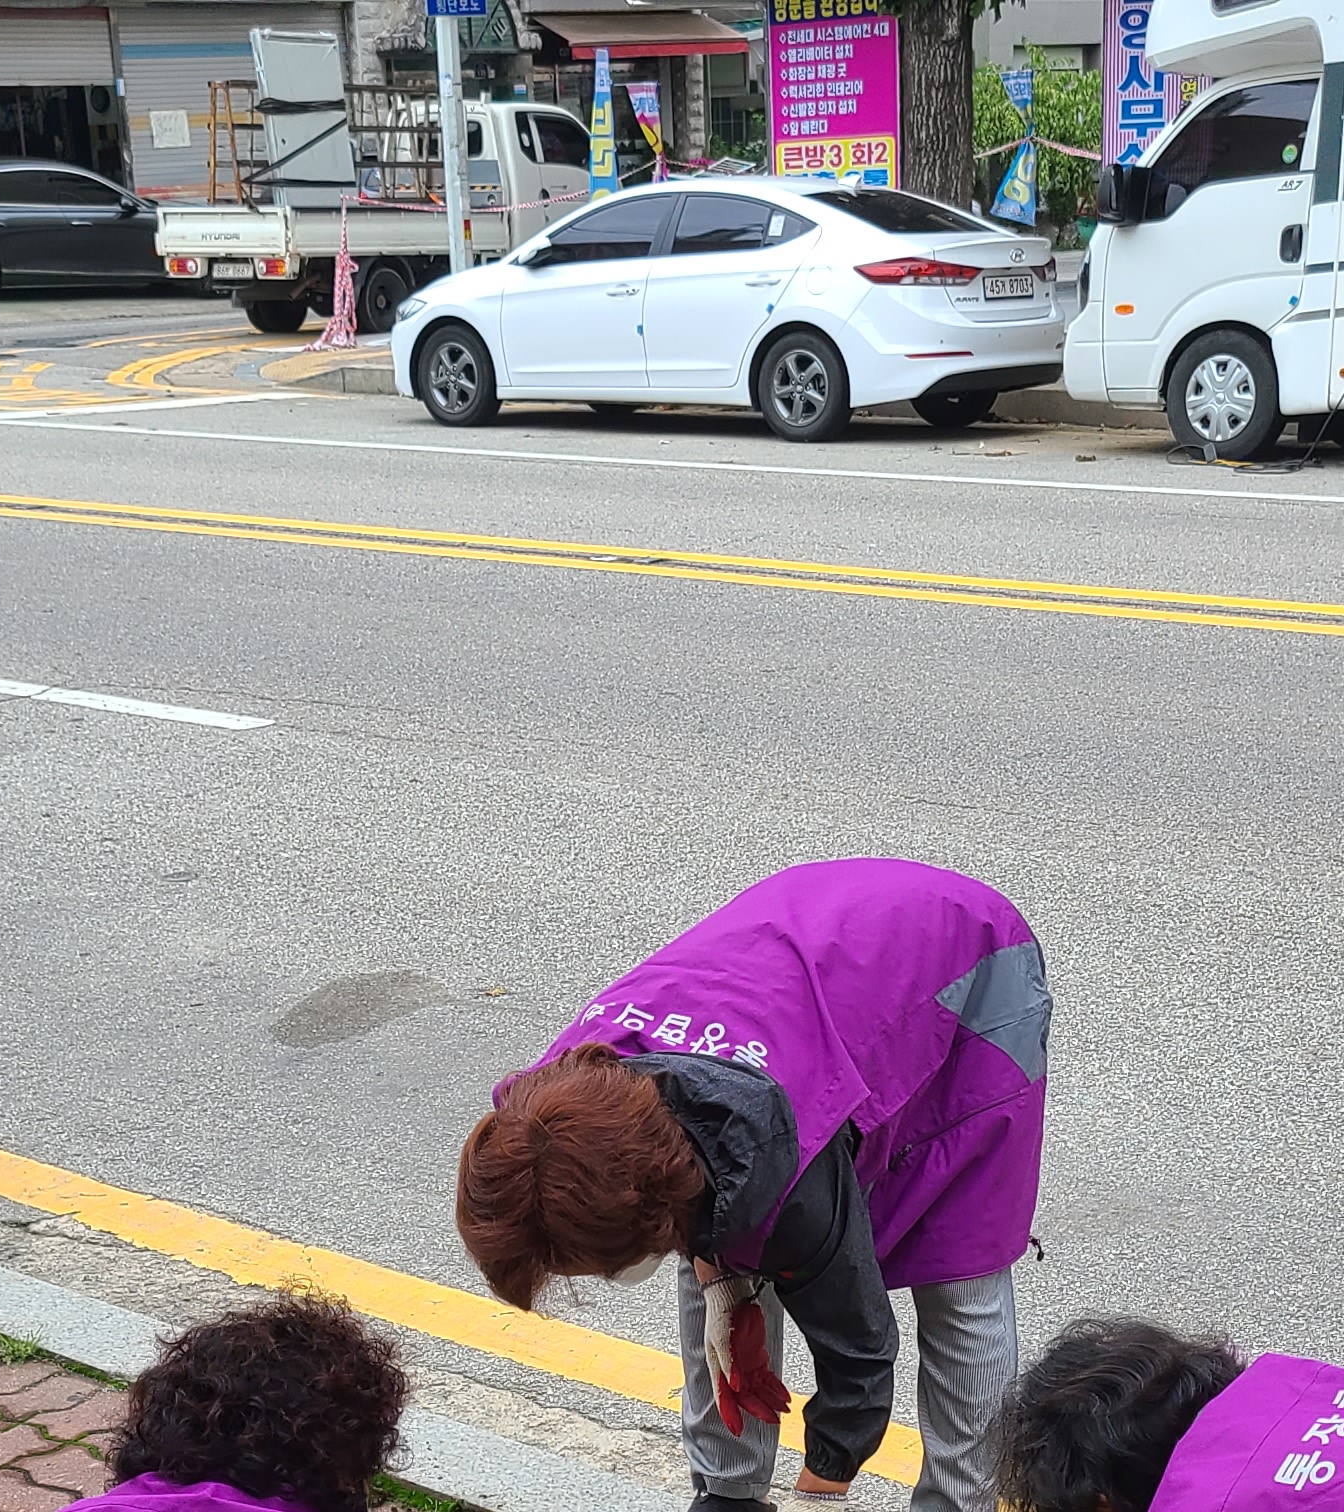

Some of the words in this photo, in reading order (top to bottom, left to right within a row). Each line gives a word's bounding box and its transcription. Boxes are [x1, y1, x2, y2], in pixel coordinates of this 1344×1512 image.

[816, 23, 871, 42] 시스템에어컨
[873, 21, 890, 37] 4대
[834, 44, 854, 60] 설치
[788, 65, 816, 82] 화장실
[827, 80, 863, 97] 인테리어
[790, 102, 816, 118] 신발장
[818, 100, 836, 115] 의자
[838, 99, 857, 115] 설치
[790, 121, 799, 136] 앞
[783, 143, 843, 170] 큰방3
[851, 141, 889, 167] 화2
[201, 232, 241, 241] HYUNDAI
[1008, 277, 1030, 294] 8703
